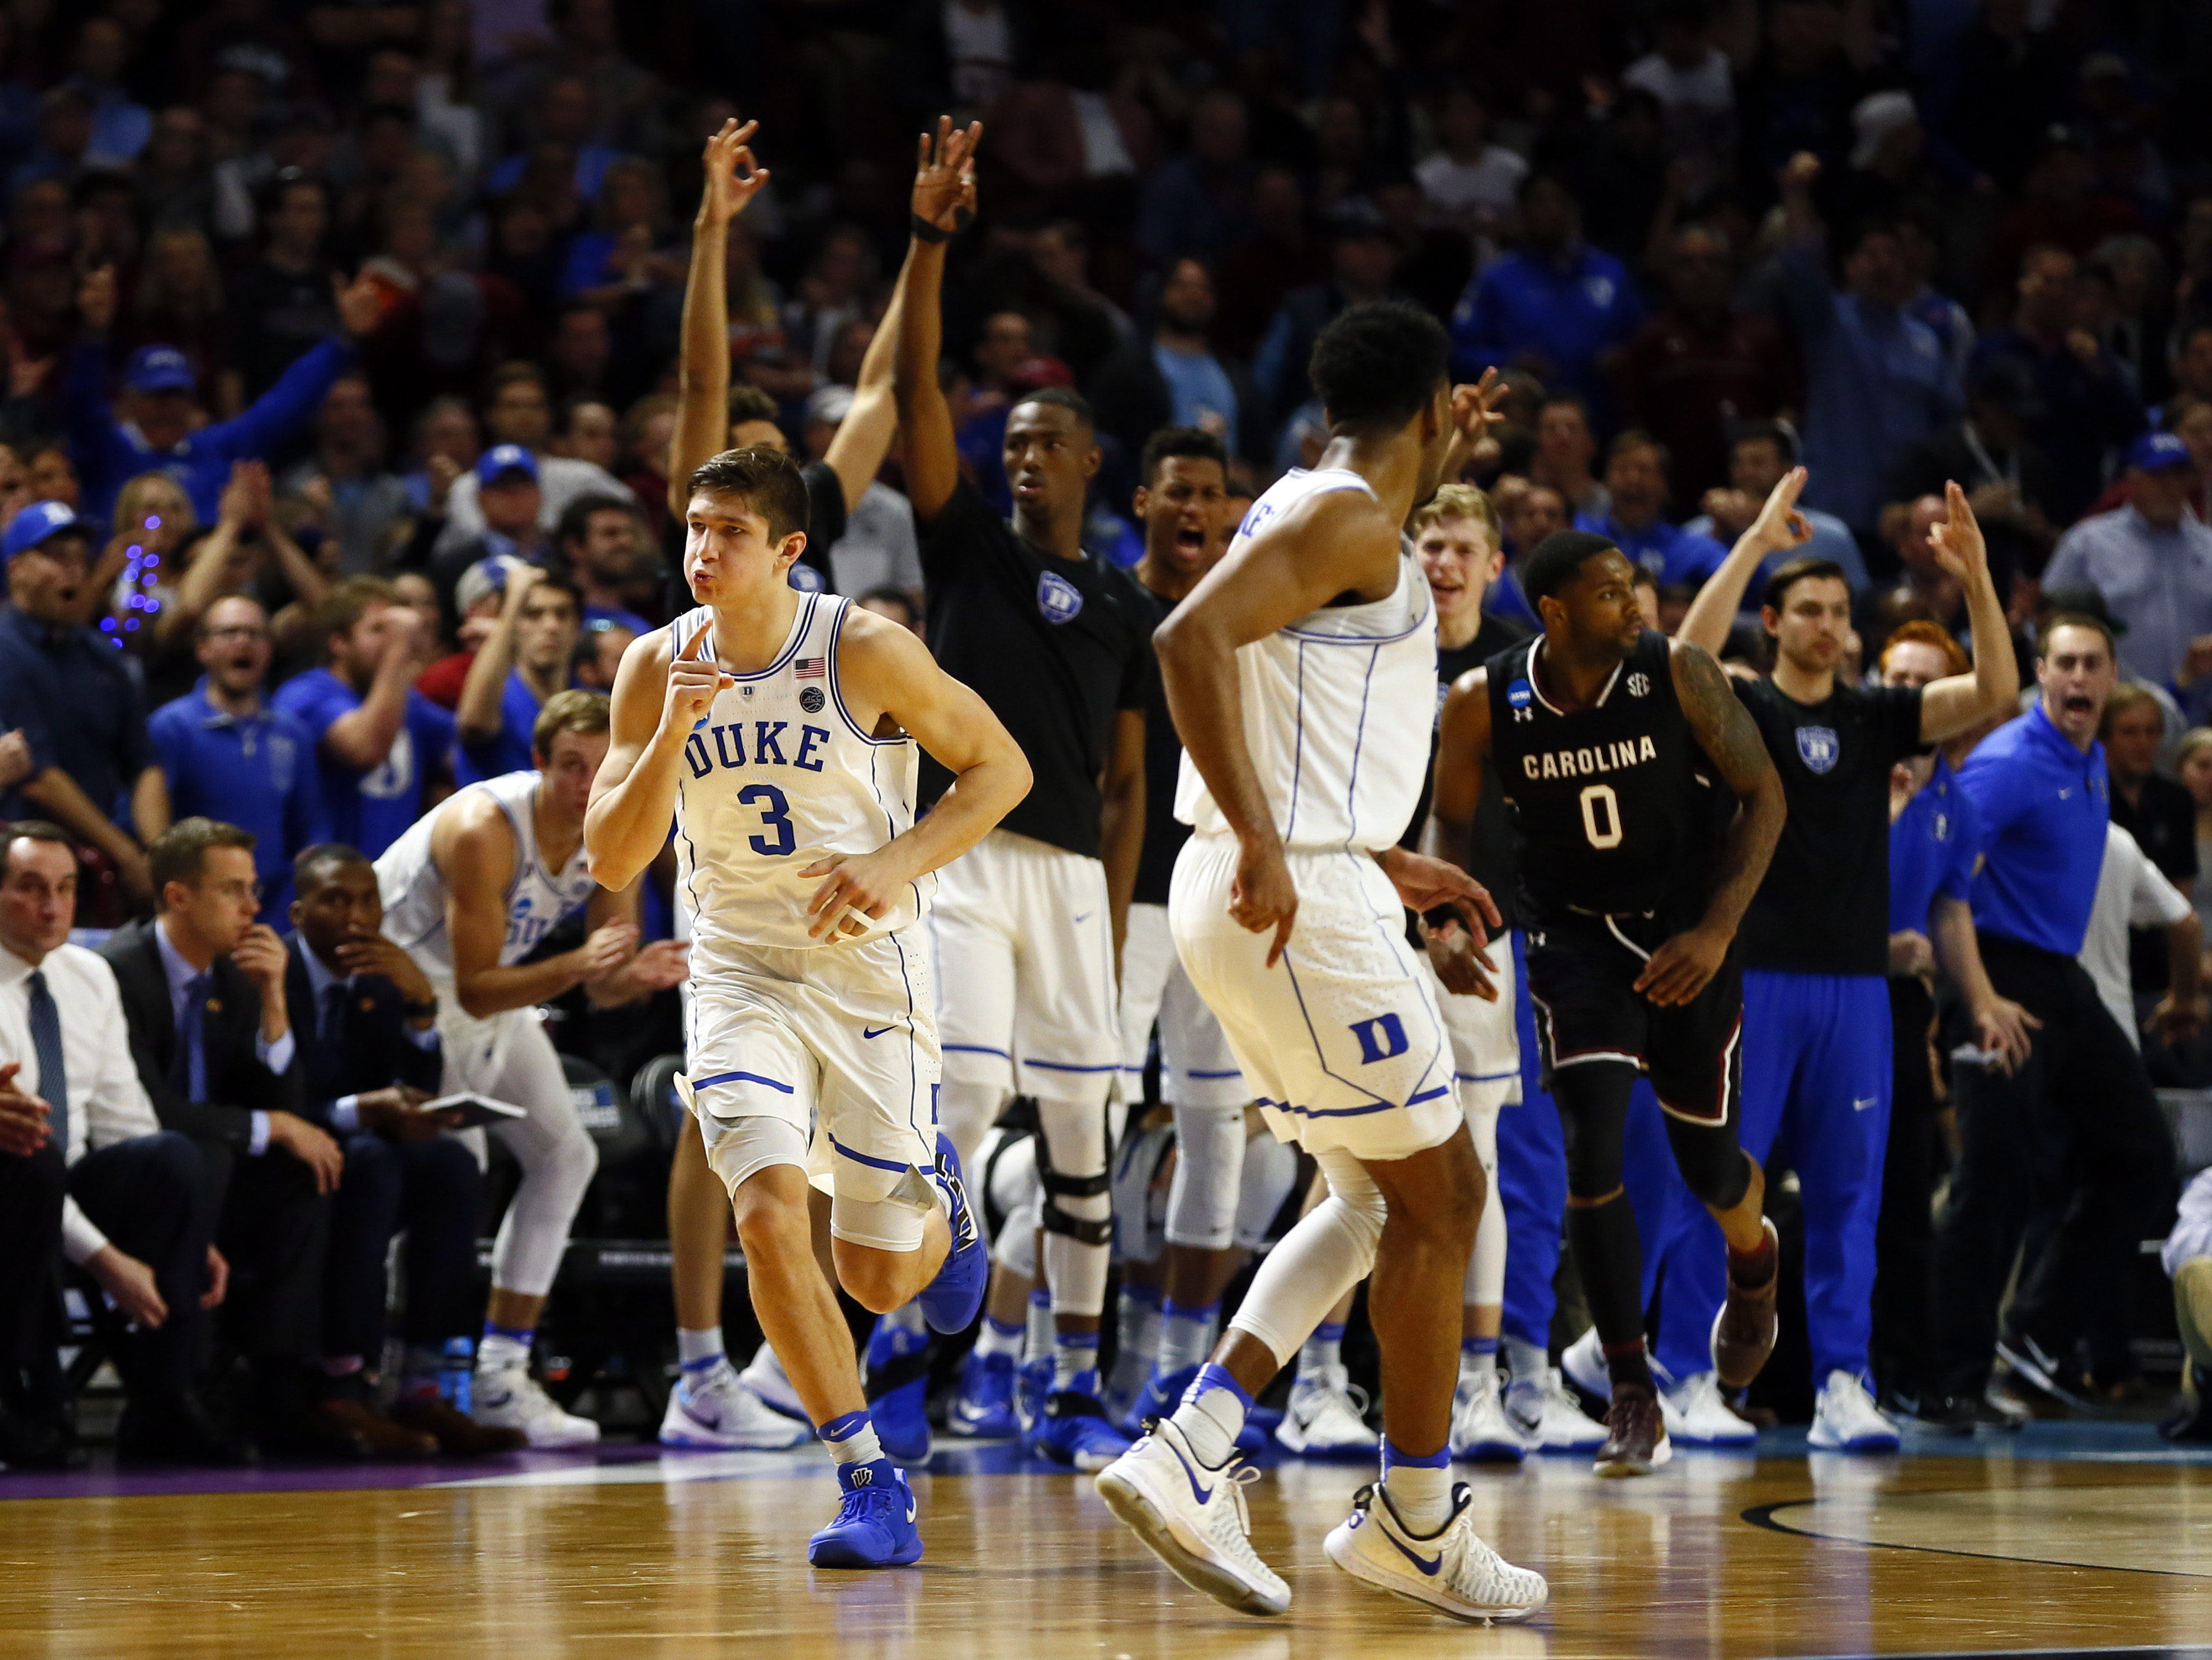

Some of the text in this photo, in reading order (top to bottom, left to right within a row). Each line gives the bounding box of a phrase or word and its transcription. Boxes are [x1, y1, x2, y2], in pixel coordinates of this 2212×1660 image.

[1626, 672, 1651, 698] SEC
[685, 721, 831, 779] DUKE
[1522, 735, 1657, 780] CAROLINA
[737, 784, 797, 856] 3
[1580, 784, 1623, 850] 0
[1348, 1012, 1410, 1065] D
